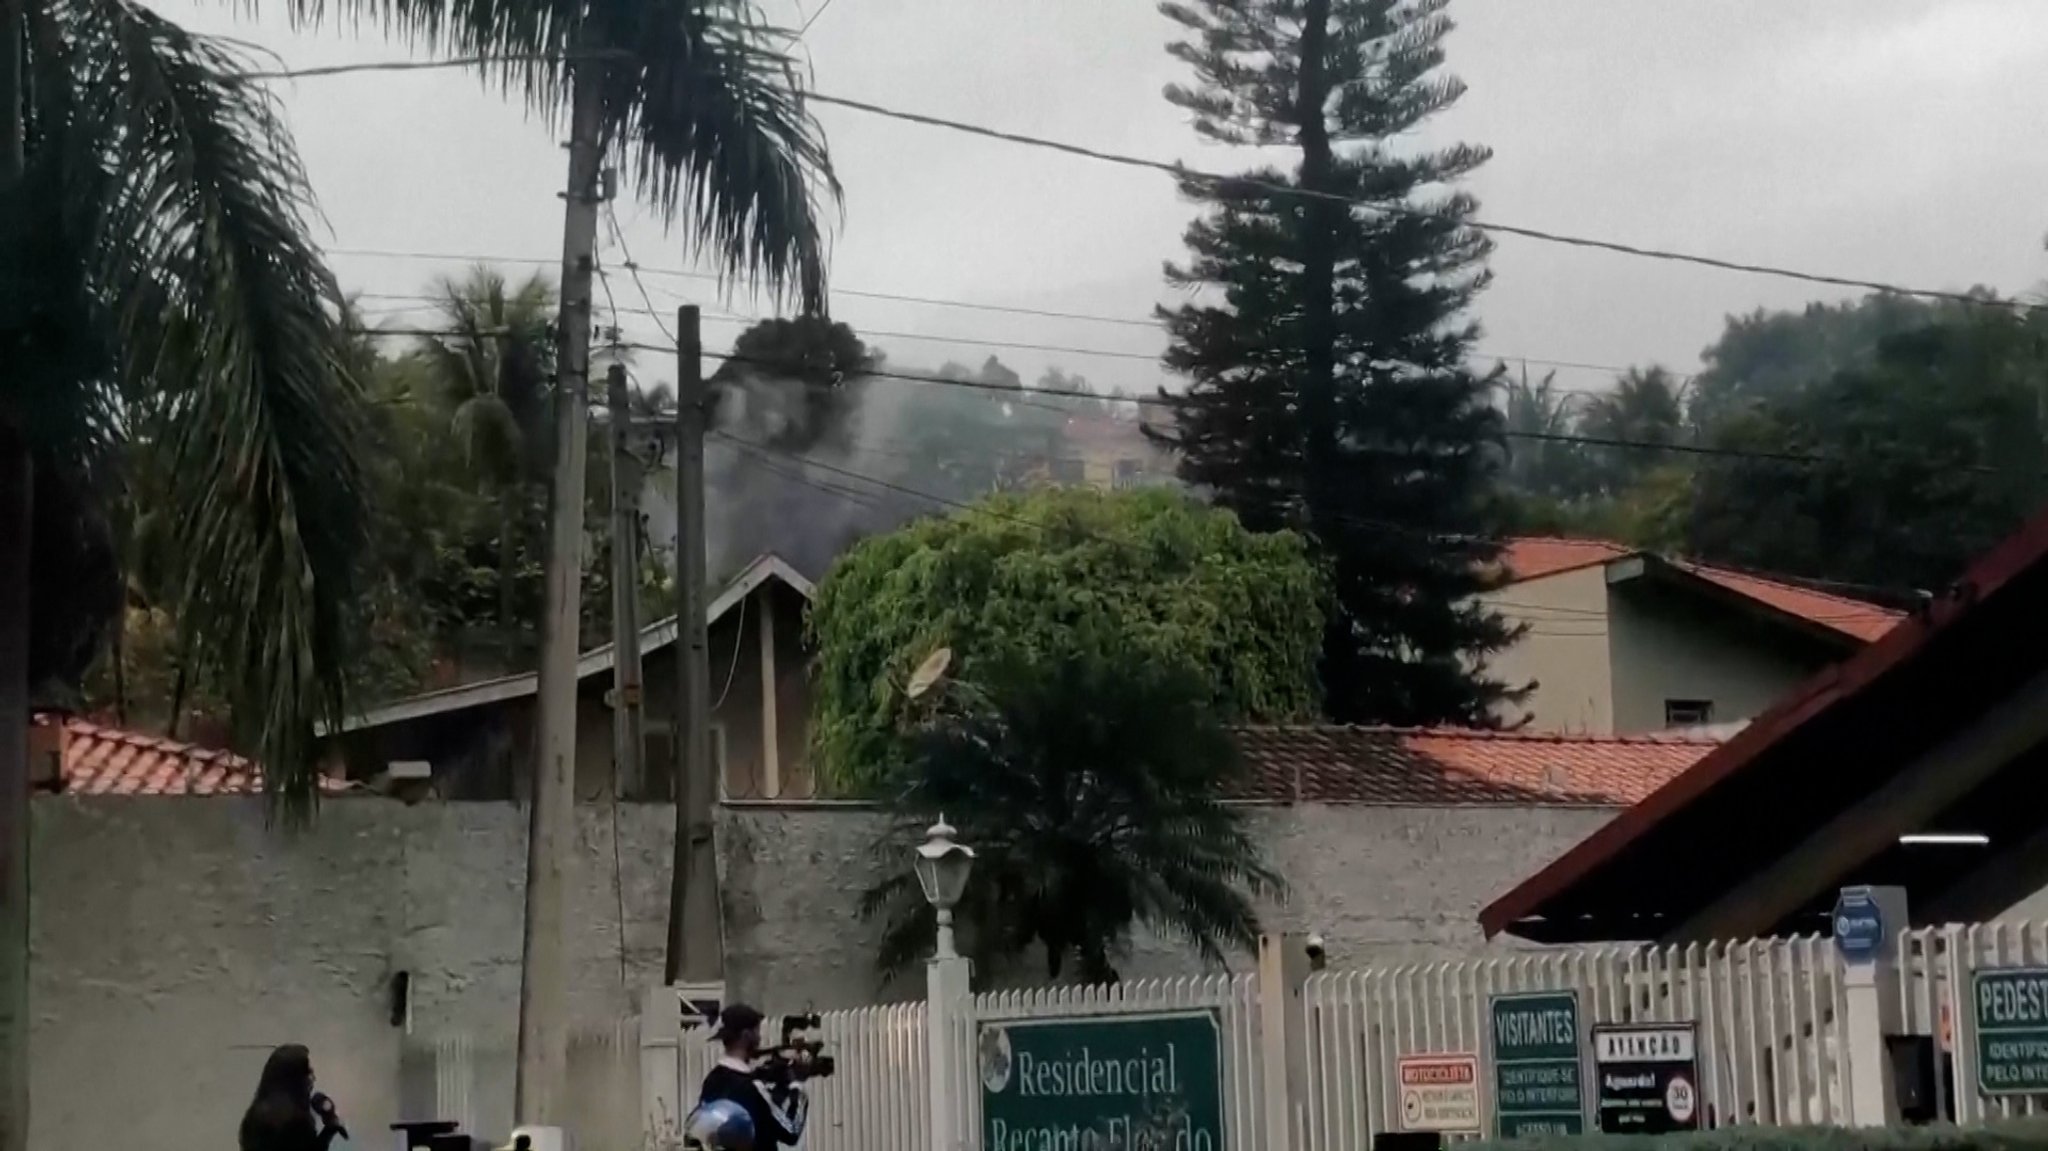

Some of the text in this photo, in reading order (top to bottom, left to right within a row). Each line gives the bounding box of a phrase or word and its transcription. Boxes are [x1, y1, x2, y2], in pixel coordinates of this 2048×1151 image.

[1497, 1009, 1573, 1046] VISITANTES
[1018, 1042, 1176, 1096] Residencial
[1986, 1064, 2020, 1081] PELO
[991, 1117, 1100, 1151] Recanto
